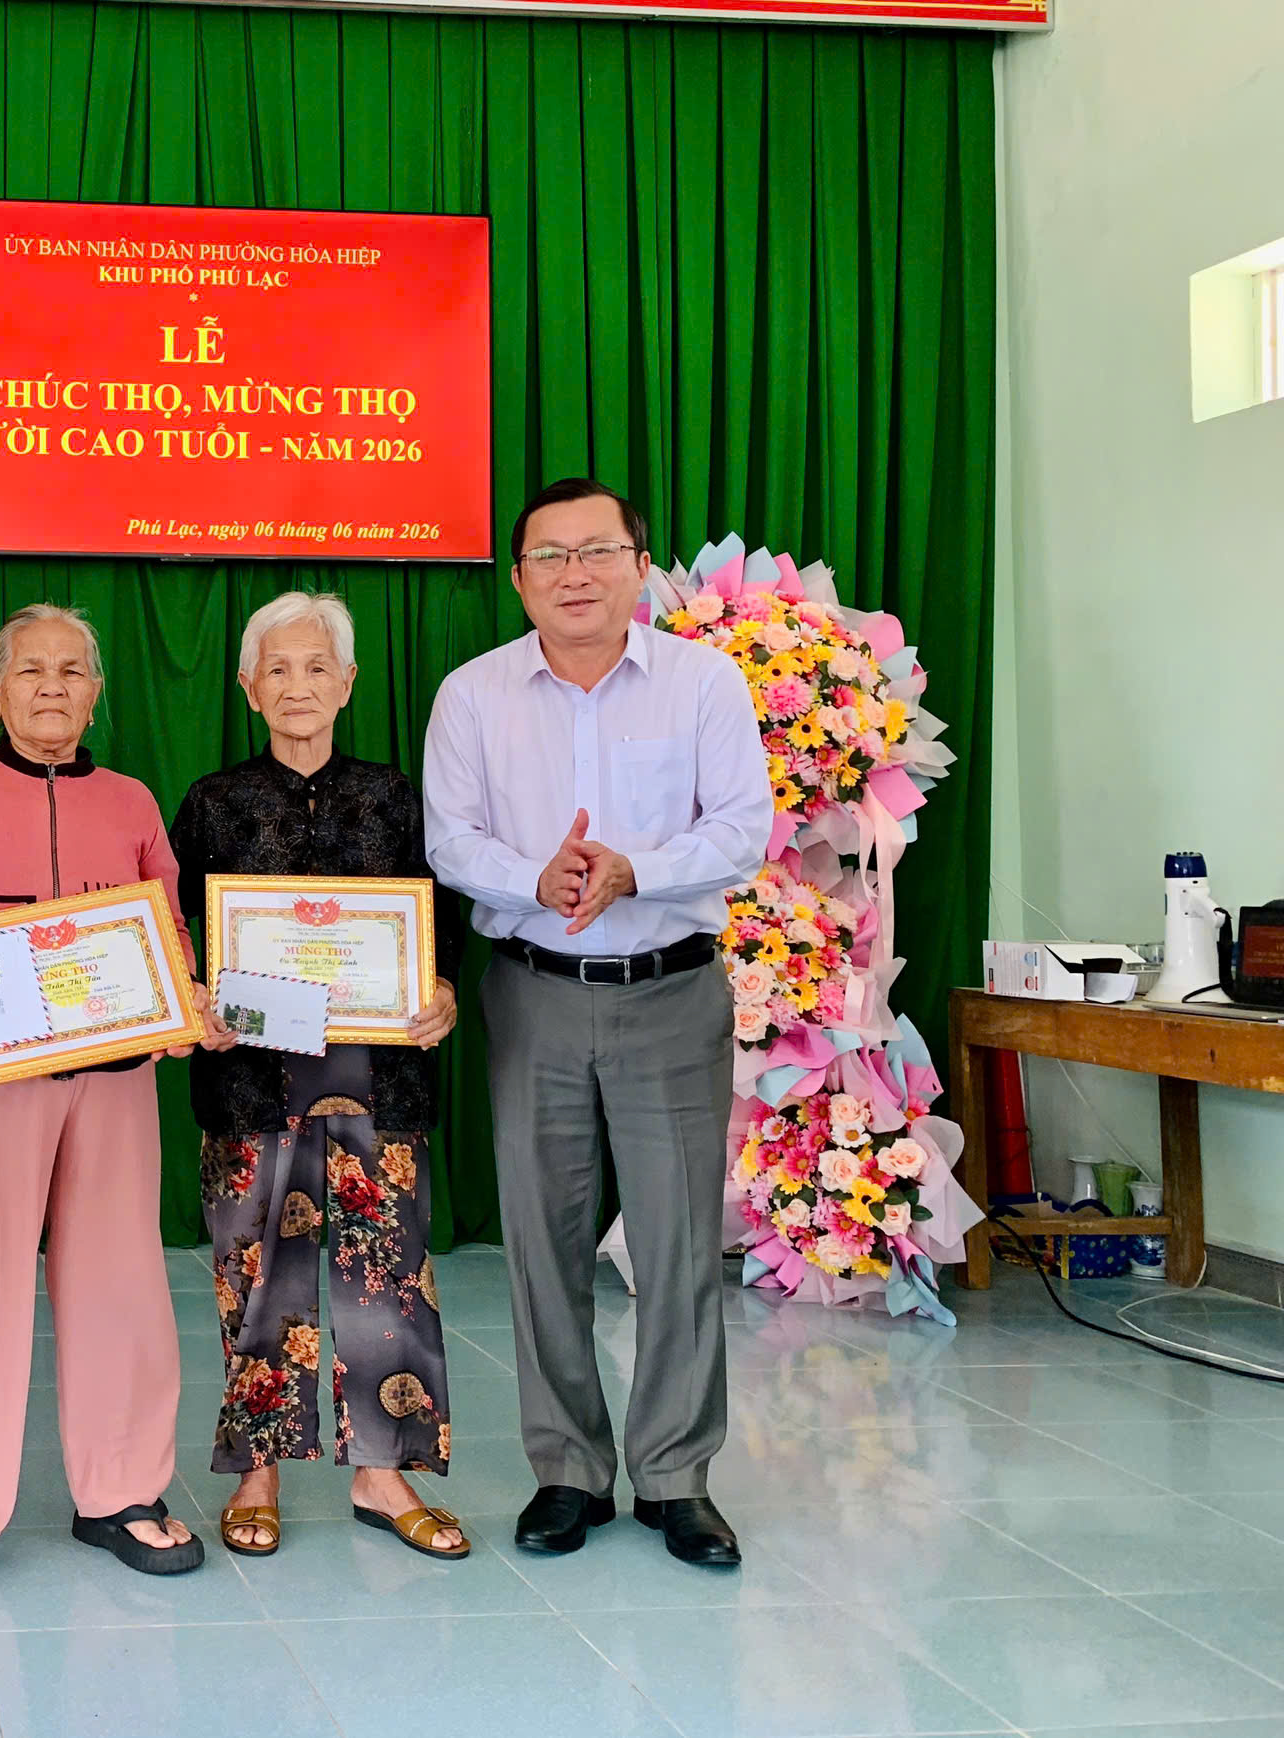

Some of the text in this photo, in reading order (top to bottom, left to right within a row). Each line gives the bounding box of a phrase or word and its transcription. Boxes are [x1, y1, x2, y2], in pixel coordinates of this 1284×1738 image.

[4, 237, 381, 267] ỦY BAN NHÂN DÂN PHƯỜNG HÒA HIỆP
[99, 264, 289, 291] KHU PHỐ PHÚ LẠC
[159, 315, 226, 364] LỄ
[98, 382, 192, 420] THỌ,
[202, 377, 325, 415] MỪNG
[333, 387, 417, 424] THỌ
[60, 427, 145, 457] CAO
[153, 422, 250, 459] TUỔI
[282, 431, 354, 461] NĂM
[361, 438, 422, 462] 2026
[126, 519, 440, 543] Phú Lạc, ngày 06 tháng 06 năm 2026
[284, 944, 352, 958] MỪNG THỌ
[73, 963, 98, 976] THỌ
